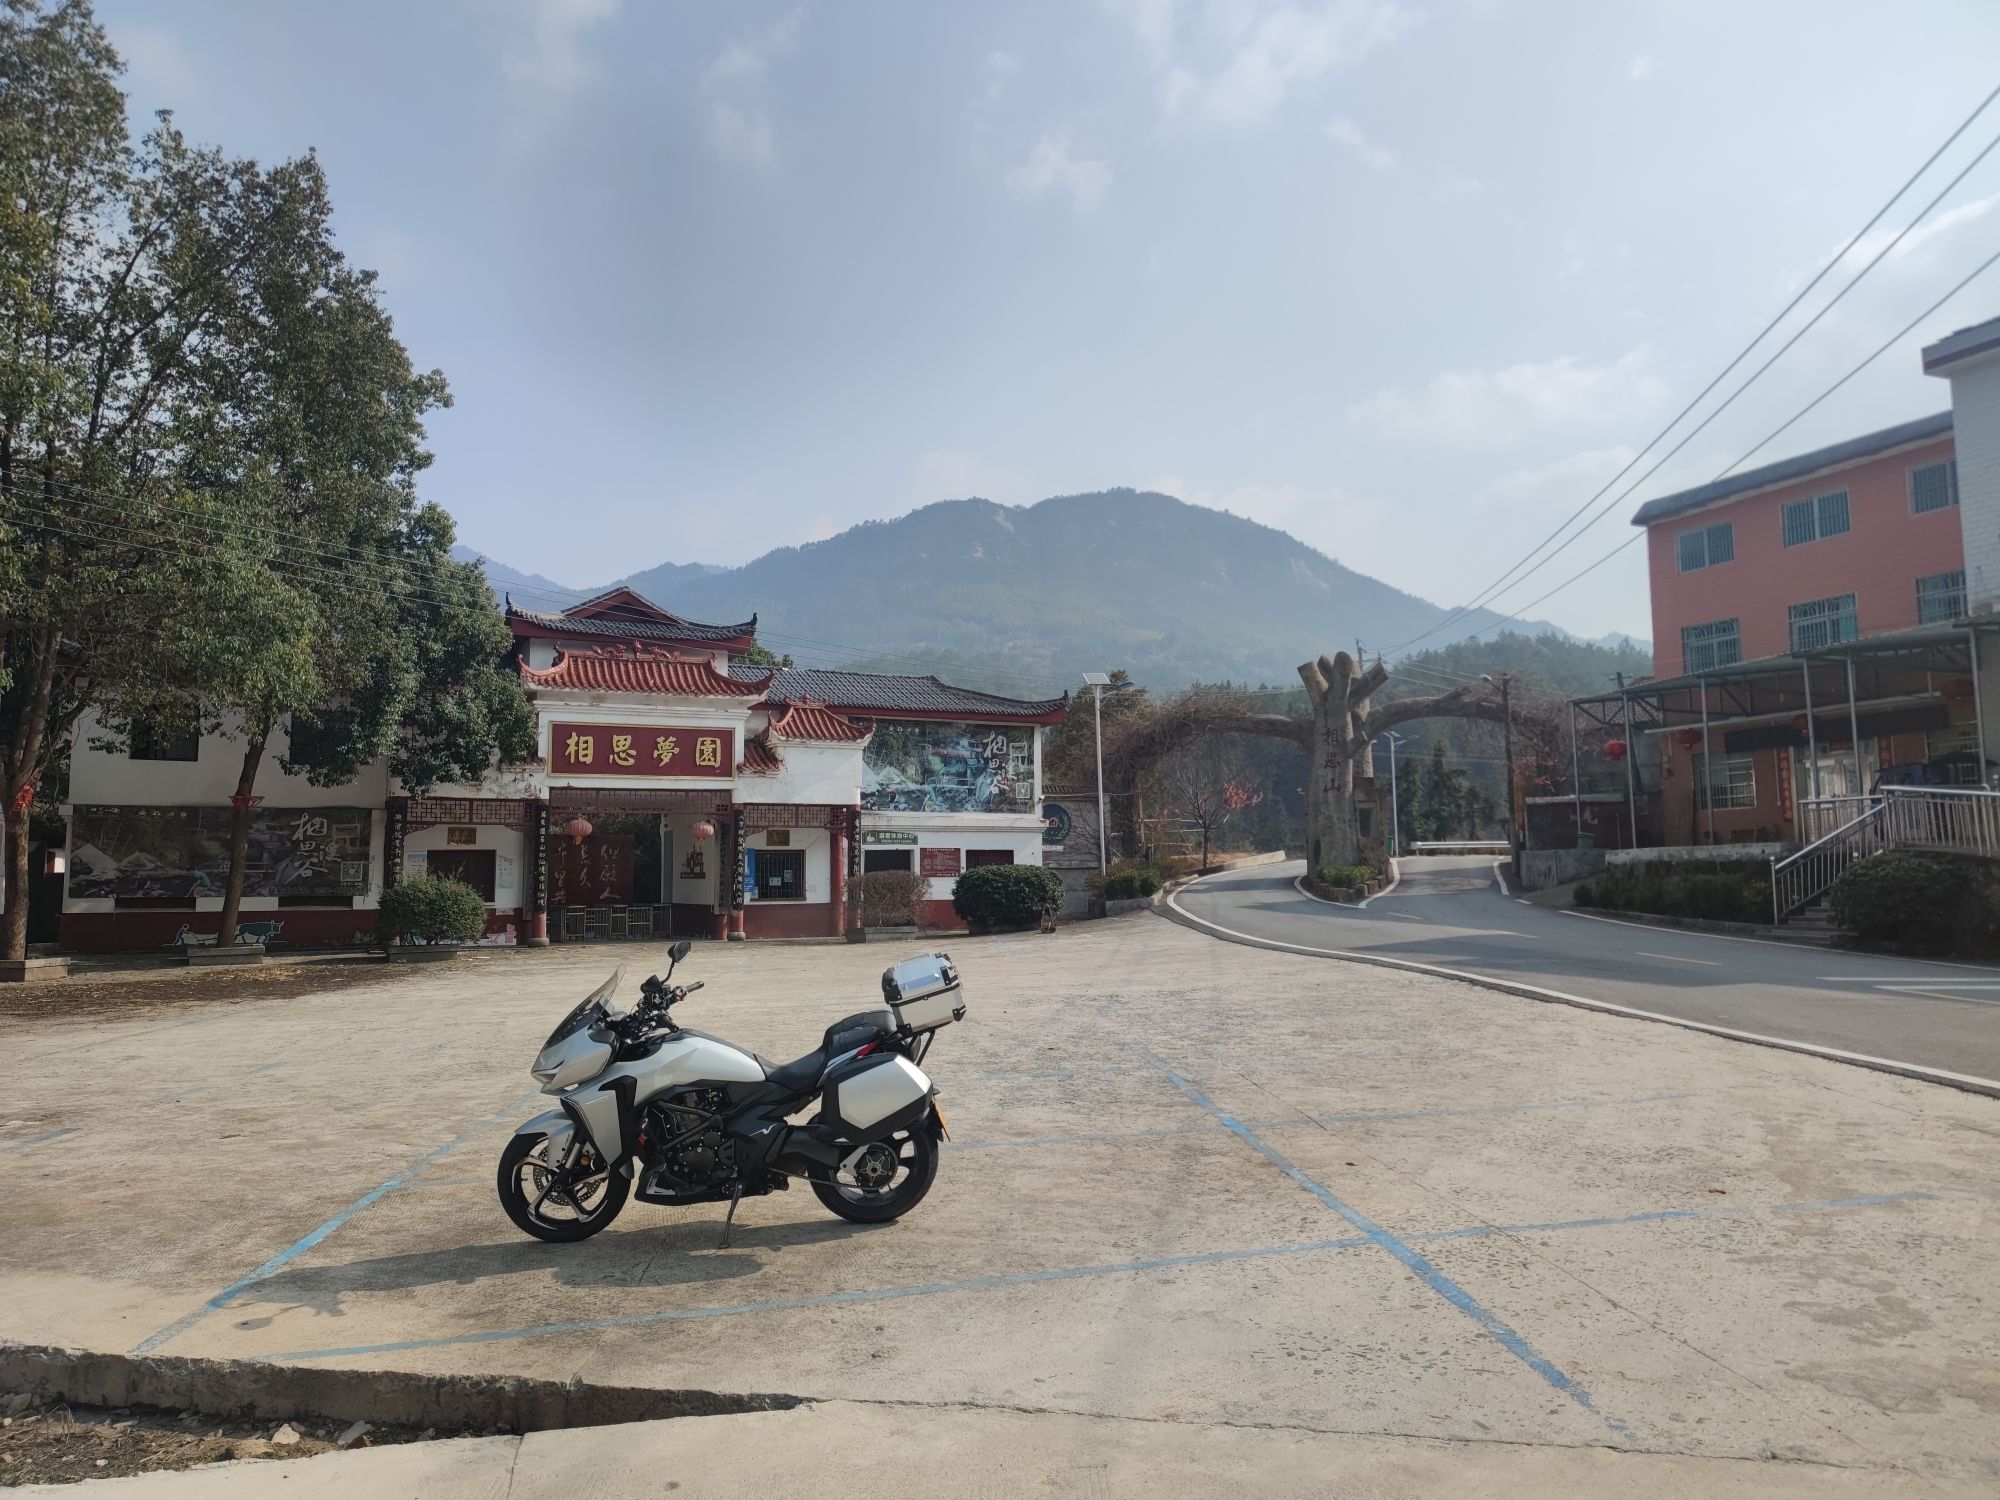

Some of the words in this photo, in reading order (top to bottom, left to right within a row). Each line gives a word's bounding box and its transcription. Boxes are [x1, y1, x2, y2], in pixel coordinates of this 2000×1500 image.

[564, 731, 721, 768] 相思夢園
[1322, 728, 1341, 792] 相思山
